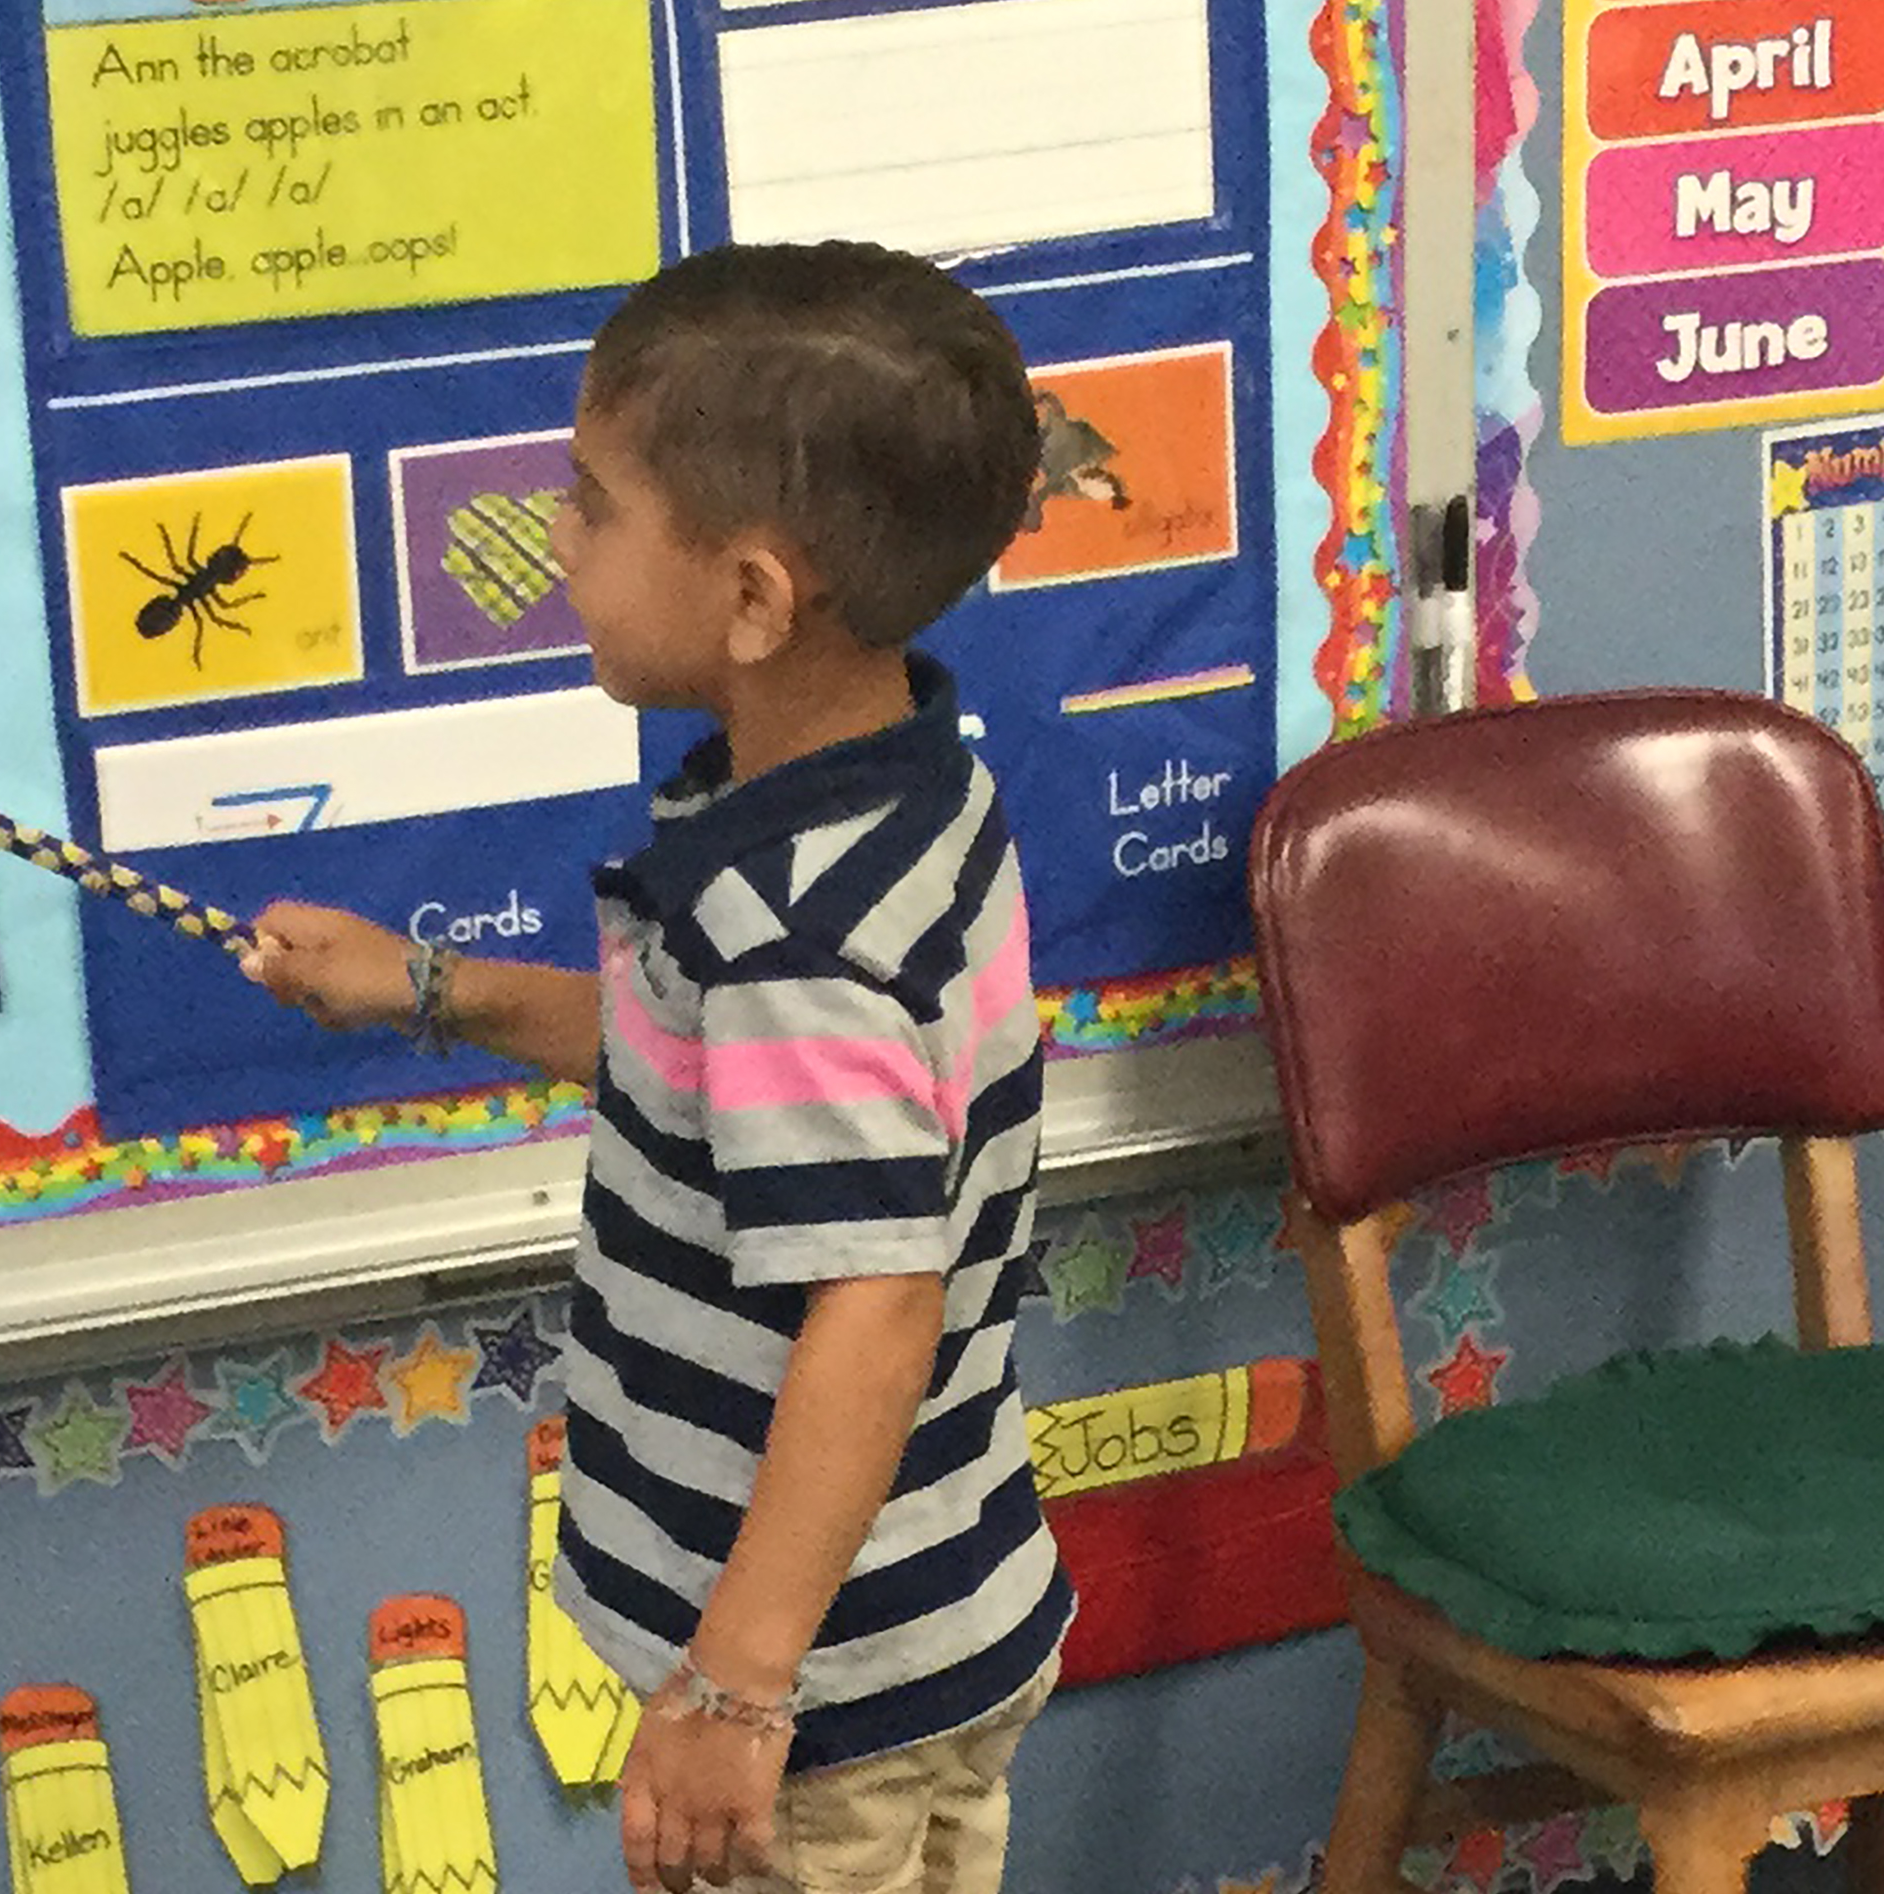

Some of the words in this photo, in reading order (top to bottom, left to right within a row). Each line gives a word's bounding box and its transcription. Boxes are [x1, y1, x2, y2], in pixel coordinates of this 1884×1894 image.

[91, 43, 179, 89] Ann
[197, 34, 254, 79] the
[270, 17, 411, 72] acrobat
[1658, 19, 1832, 118] April
[94, 106, 231, 178] juggles
[244, 94, 361, 159] apples
[419, 99, 463, 127] an
[1676, 170, 1814, 243] May
[1655, 311, 1828, 383] June
[1108, 759, 1232, 817] Letter
[1114, 821, 1229, 877] Cards
[409, 890, 543, 949] Cards
[1061, 1409, 1200, 1477] Jobs
[209, 1649, 299, 1693] Claire
[385, 1741, 475, 1785] Graham
